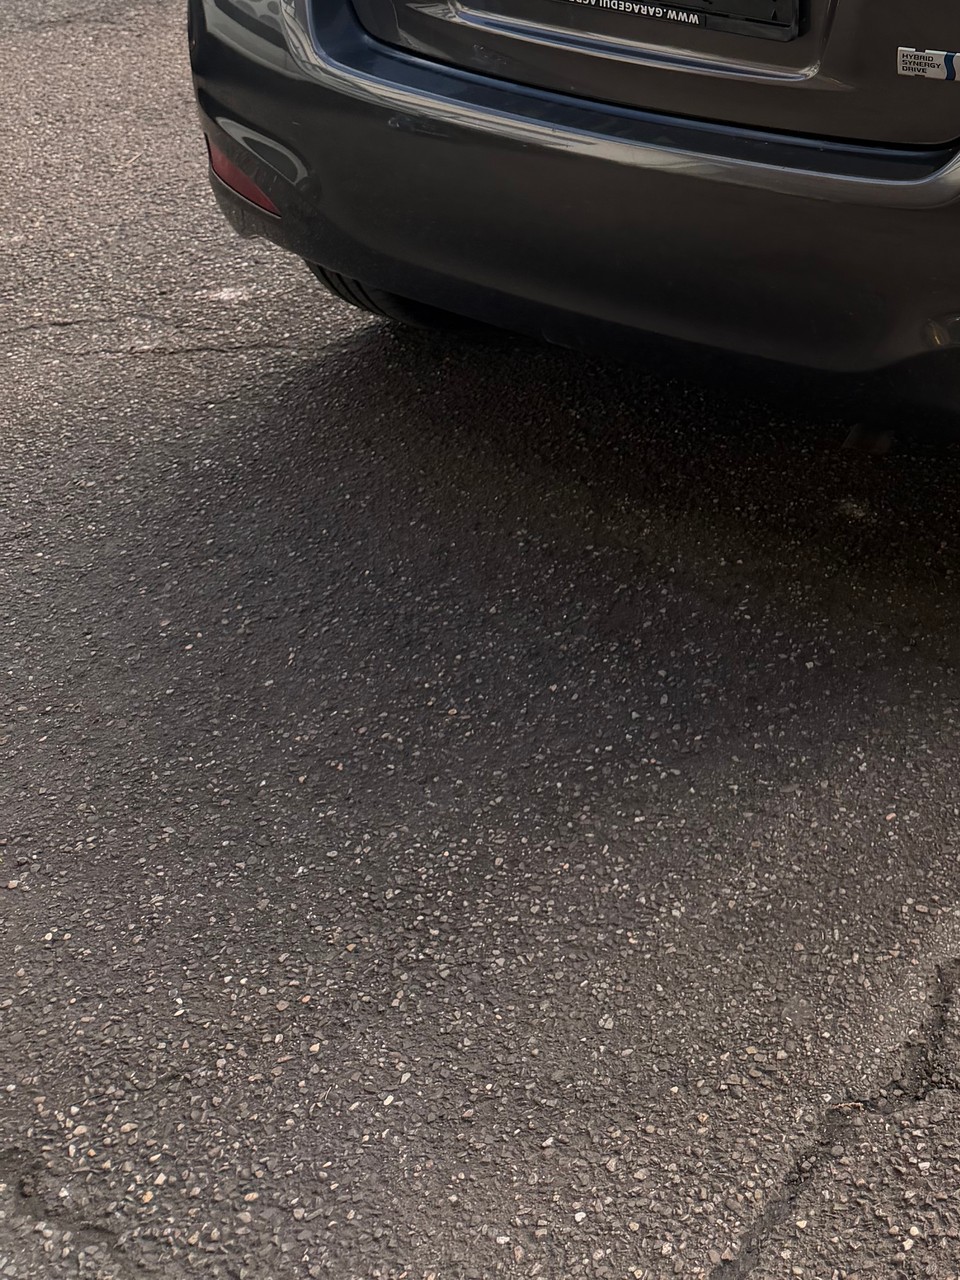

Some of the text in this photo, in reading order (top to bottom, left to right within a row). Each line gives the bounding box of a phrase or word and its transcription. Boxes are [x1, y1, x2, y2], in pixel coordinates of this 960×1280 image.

[902, 53, 934, 62] HYBRID
[902, 59, 942, 69] SYNERGY
[902, 65, 927, 74] DRIVE
